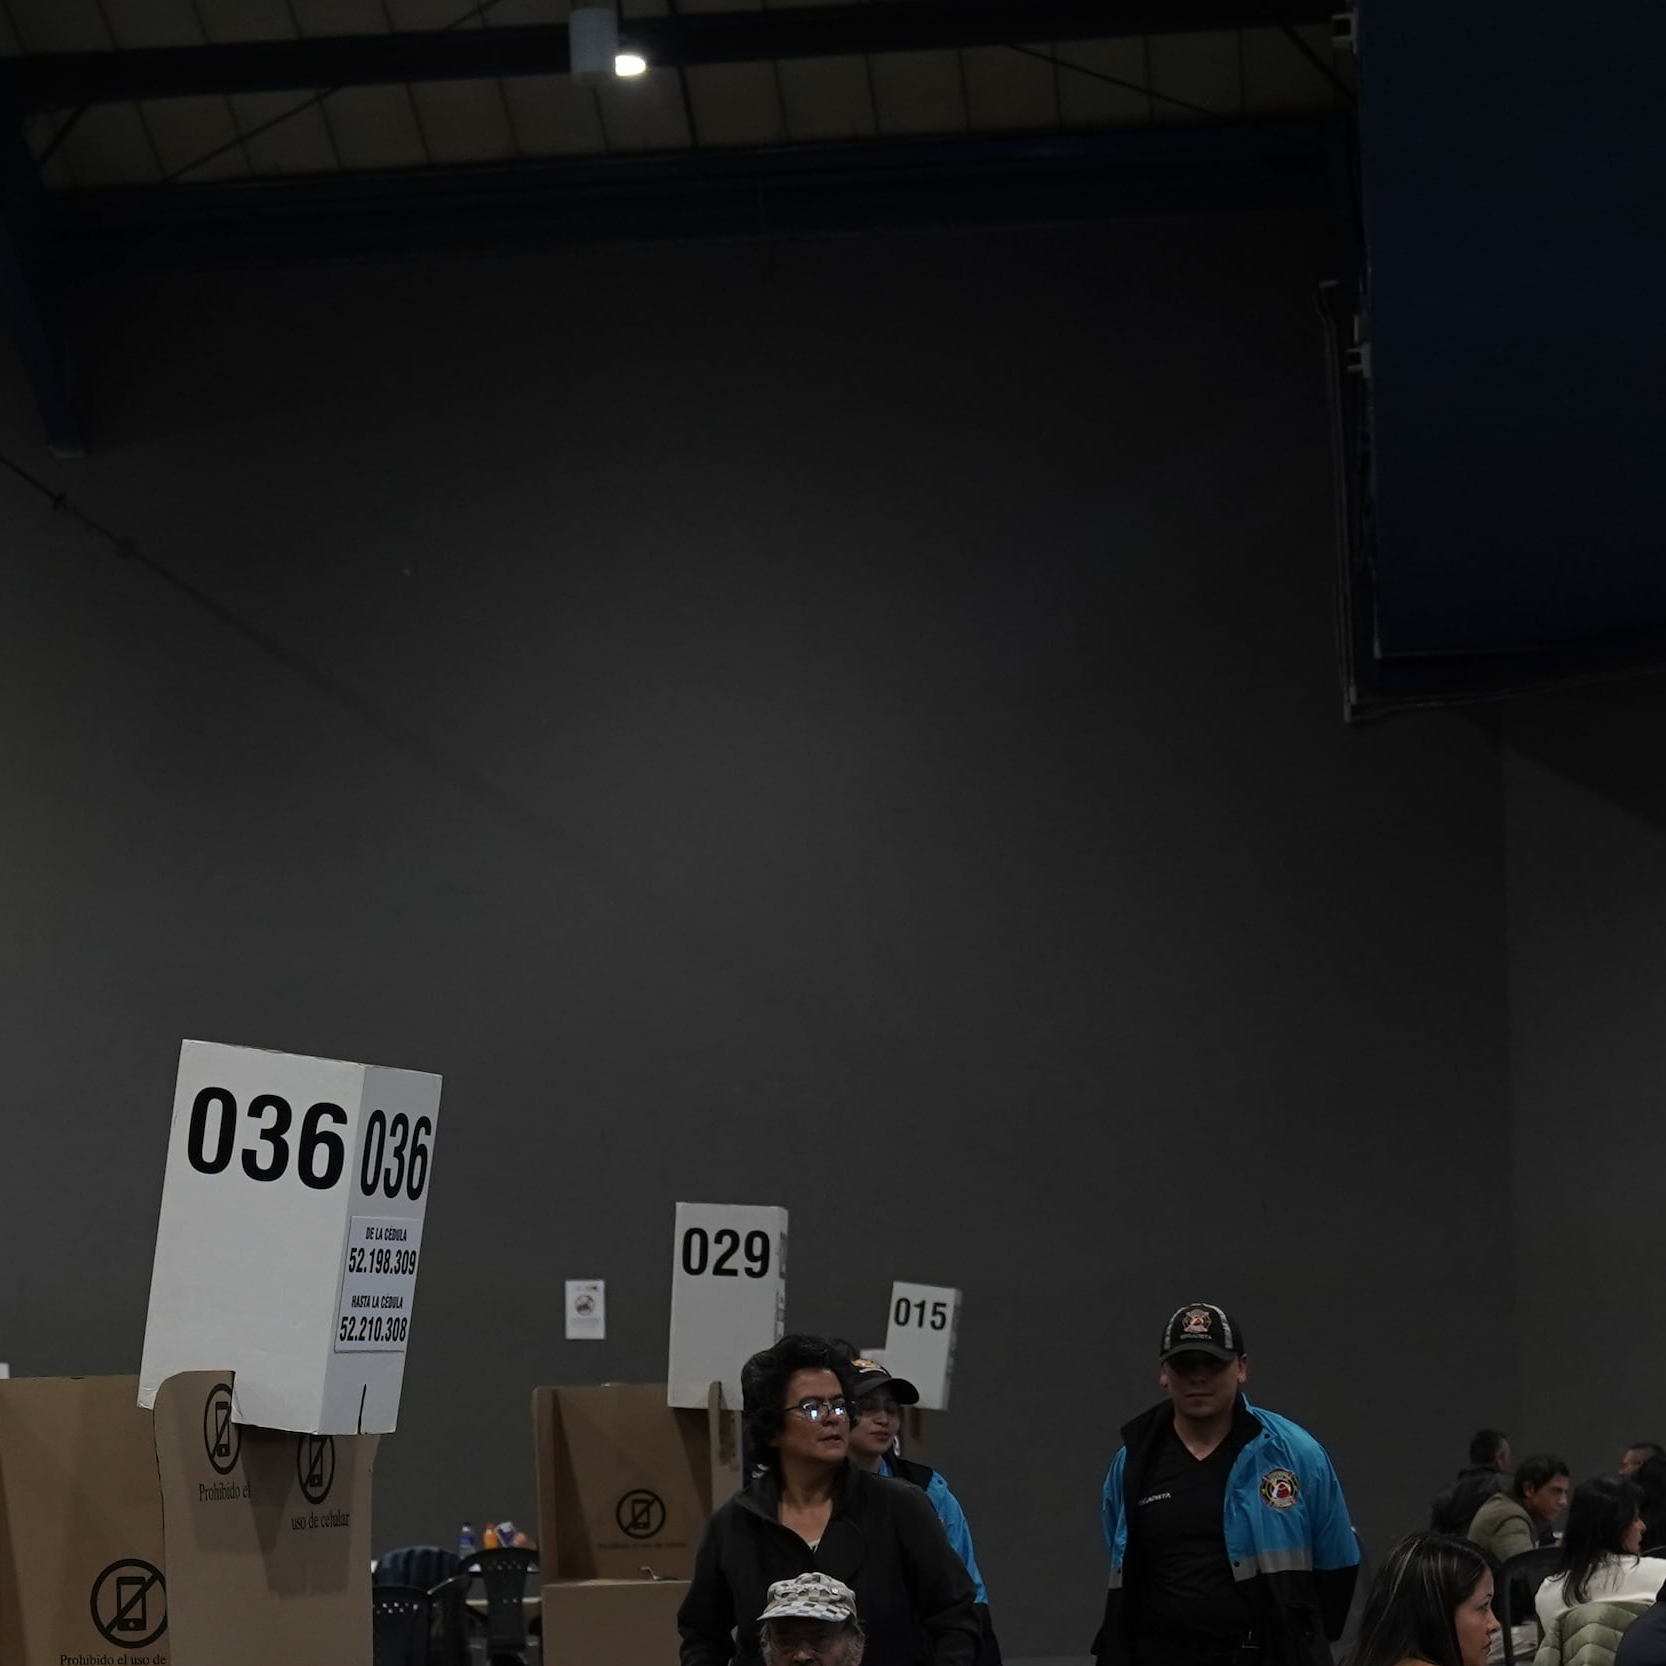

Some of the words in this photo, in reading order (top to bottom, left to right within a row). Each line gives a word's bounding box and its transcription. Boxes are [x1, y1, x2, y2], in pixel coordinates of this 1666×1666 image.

[188, 1086, 348, 1190] 036
[360, 1109, 432, 1201] 036
[365, 1227, 374, 1240] DE
[375, 1227, 383, 1240] LA
[384, 1225, 407, 1241] CÉDULA
[348, 1247, 417, 1275] 52.198.309
[683, 1227, 770, 1278] 029
[351, 1295, 371, 1308] HASTA
[372, 1295, 379, 1308] LA
[380, 1293, 403, 1309] CÉDULA
[894, 1298, 947, 1330] 015
[339, 1316, 408, 1342] 52.210.308
[199, 1481, 240, 1501] Prohibido
[242, 1480, 252, 1499] el
[291, 1517, 307, 1530] uso
[308, 1512, 319, 1528] de
[320, 1509, 350, 1528] celular
[60, 1654, 114, 1666] Prohibido
[117, 1653, 127, 1665] el
[131, 1655, 150, 1665] uso
[153, 1653, 167, 1665] de
